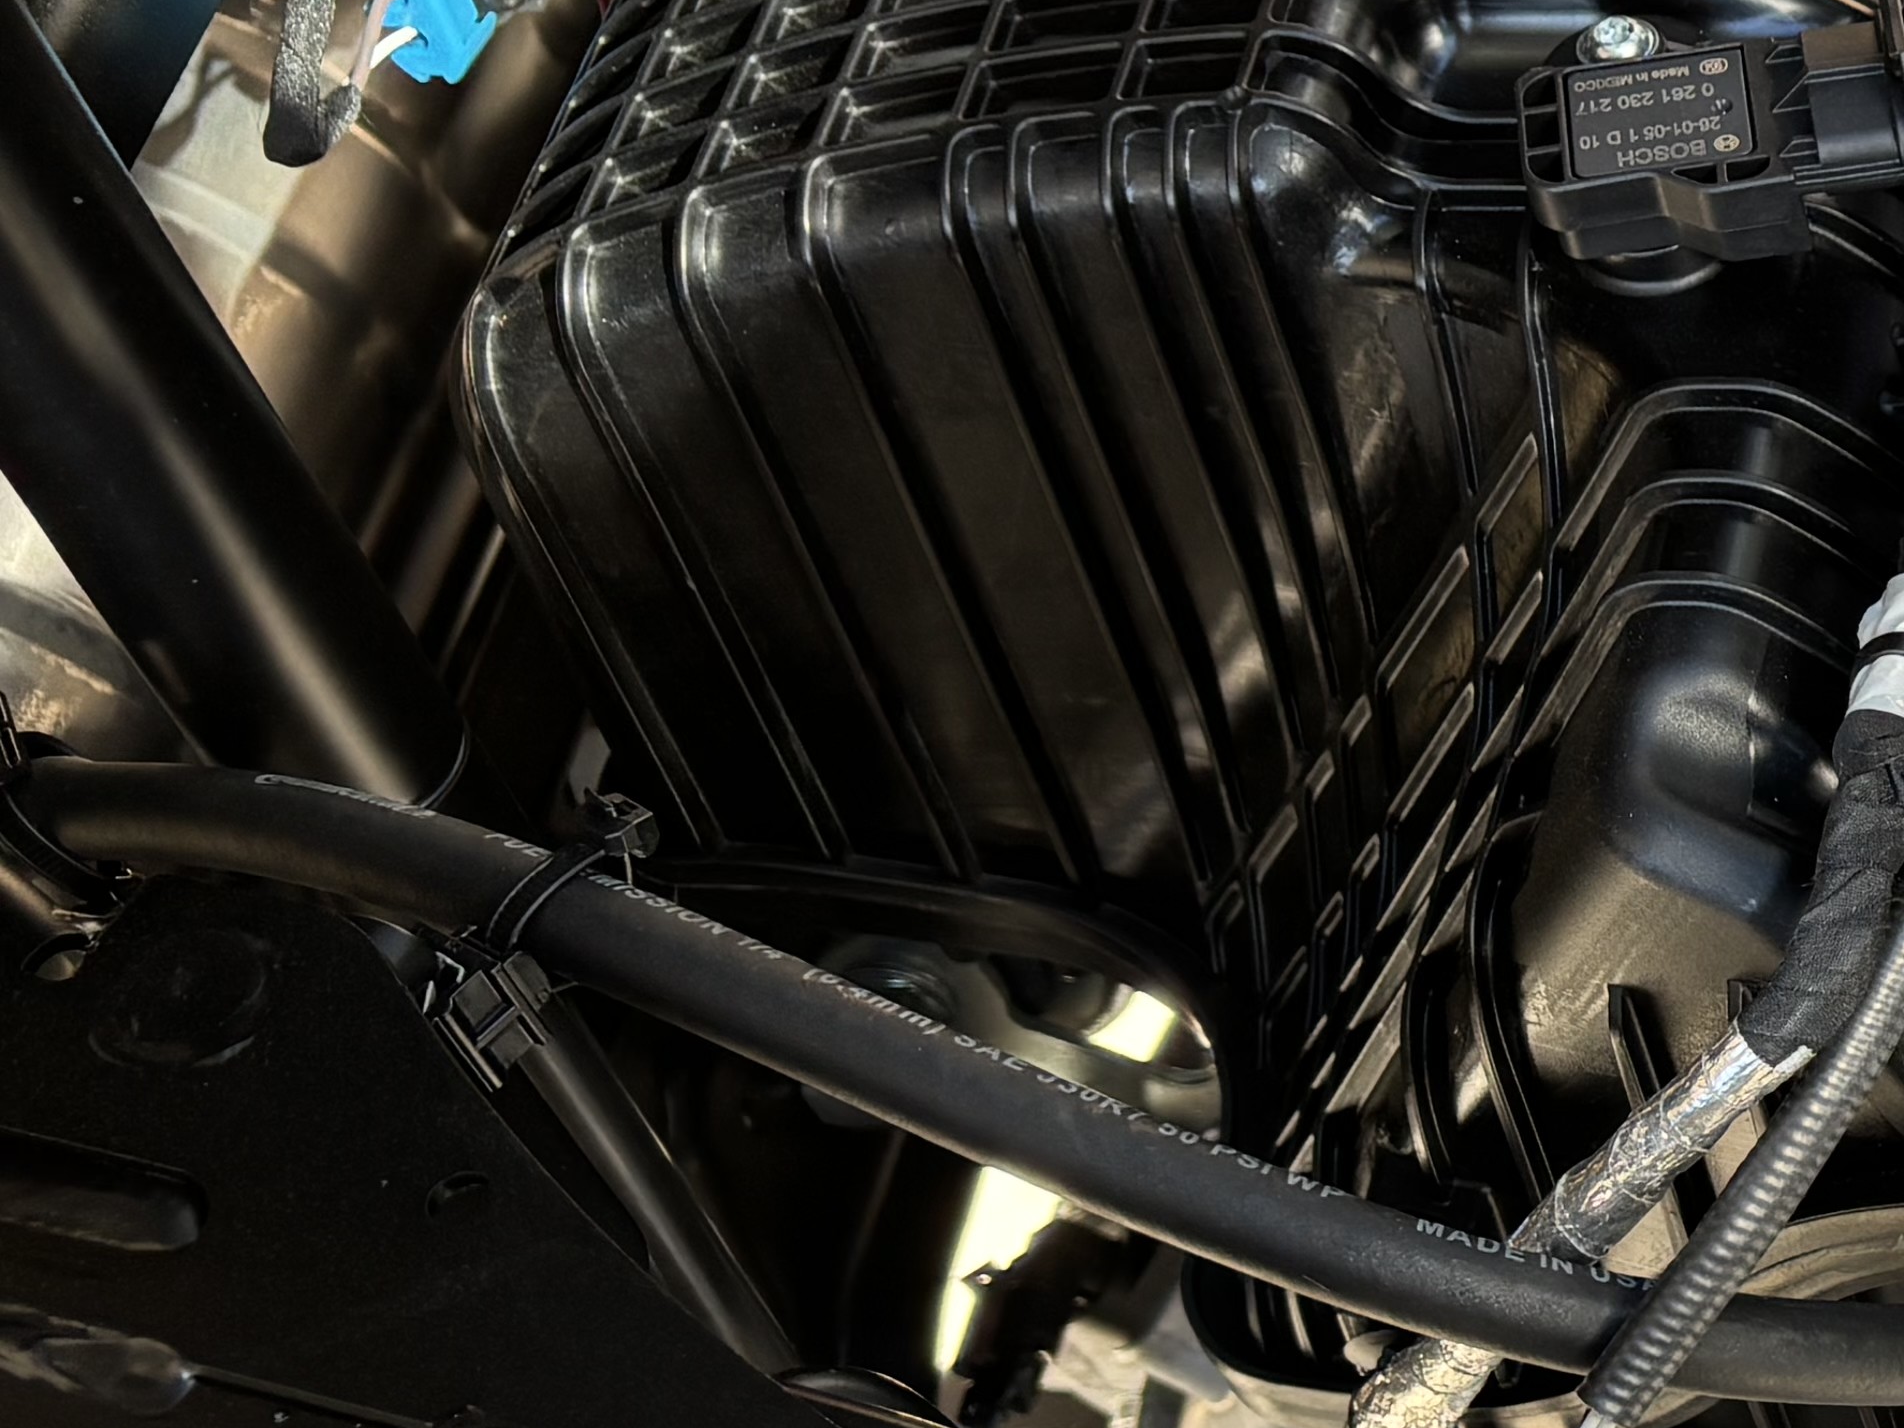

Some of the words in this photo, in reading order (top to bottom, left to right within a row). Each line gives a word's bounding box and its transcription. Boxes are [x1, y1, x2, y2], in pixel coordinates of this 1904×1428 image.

[1652, 66, 1691, 80] Made
[1574, 75, 1633, 93] MEXICO
[1702, 83, 1715, 98] 0
[1617, 91, 1654, 110] 230
[1661, 85, 1696, 103] 261
[1575, 98, 1613, 117] 217
[1579, 135, 1600, 151] 10
[1606, 130, 1622, 145] D
[1616, 139, 1707, 168] BOSCH
[484, 831, 555, 860] FUE
[580, 868, 731, 938] MISSION
[953, 1033, 1030, 1073] SAE
[1208, 1142, 1279, 1176] PSI
[1285, 1171, 1349, 1200] WP
[1415, 1217, 1526, 1264] MADE
[1539, 1253, 1575, 1276] IN
